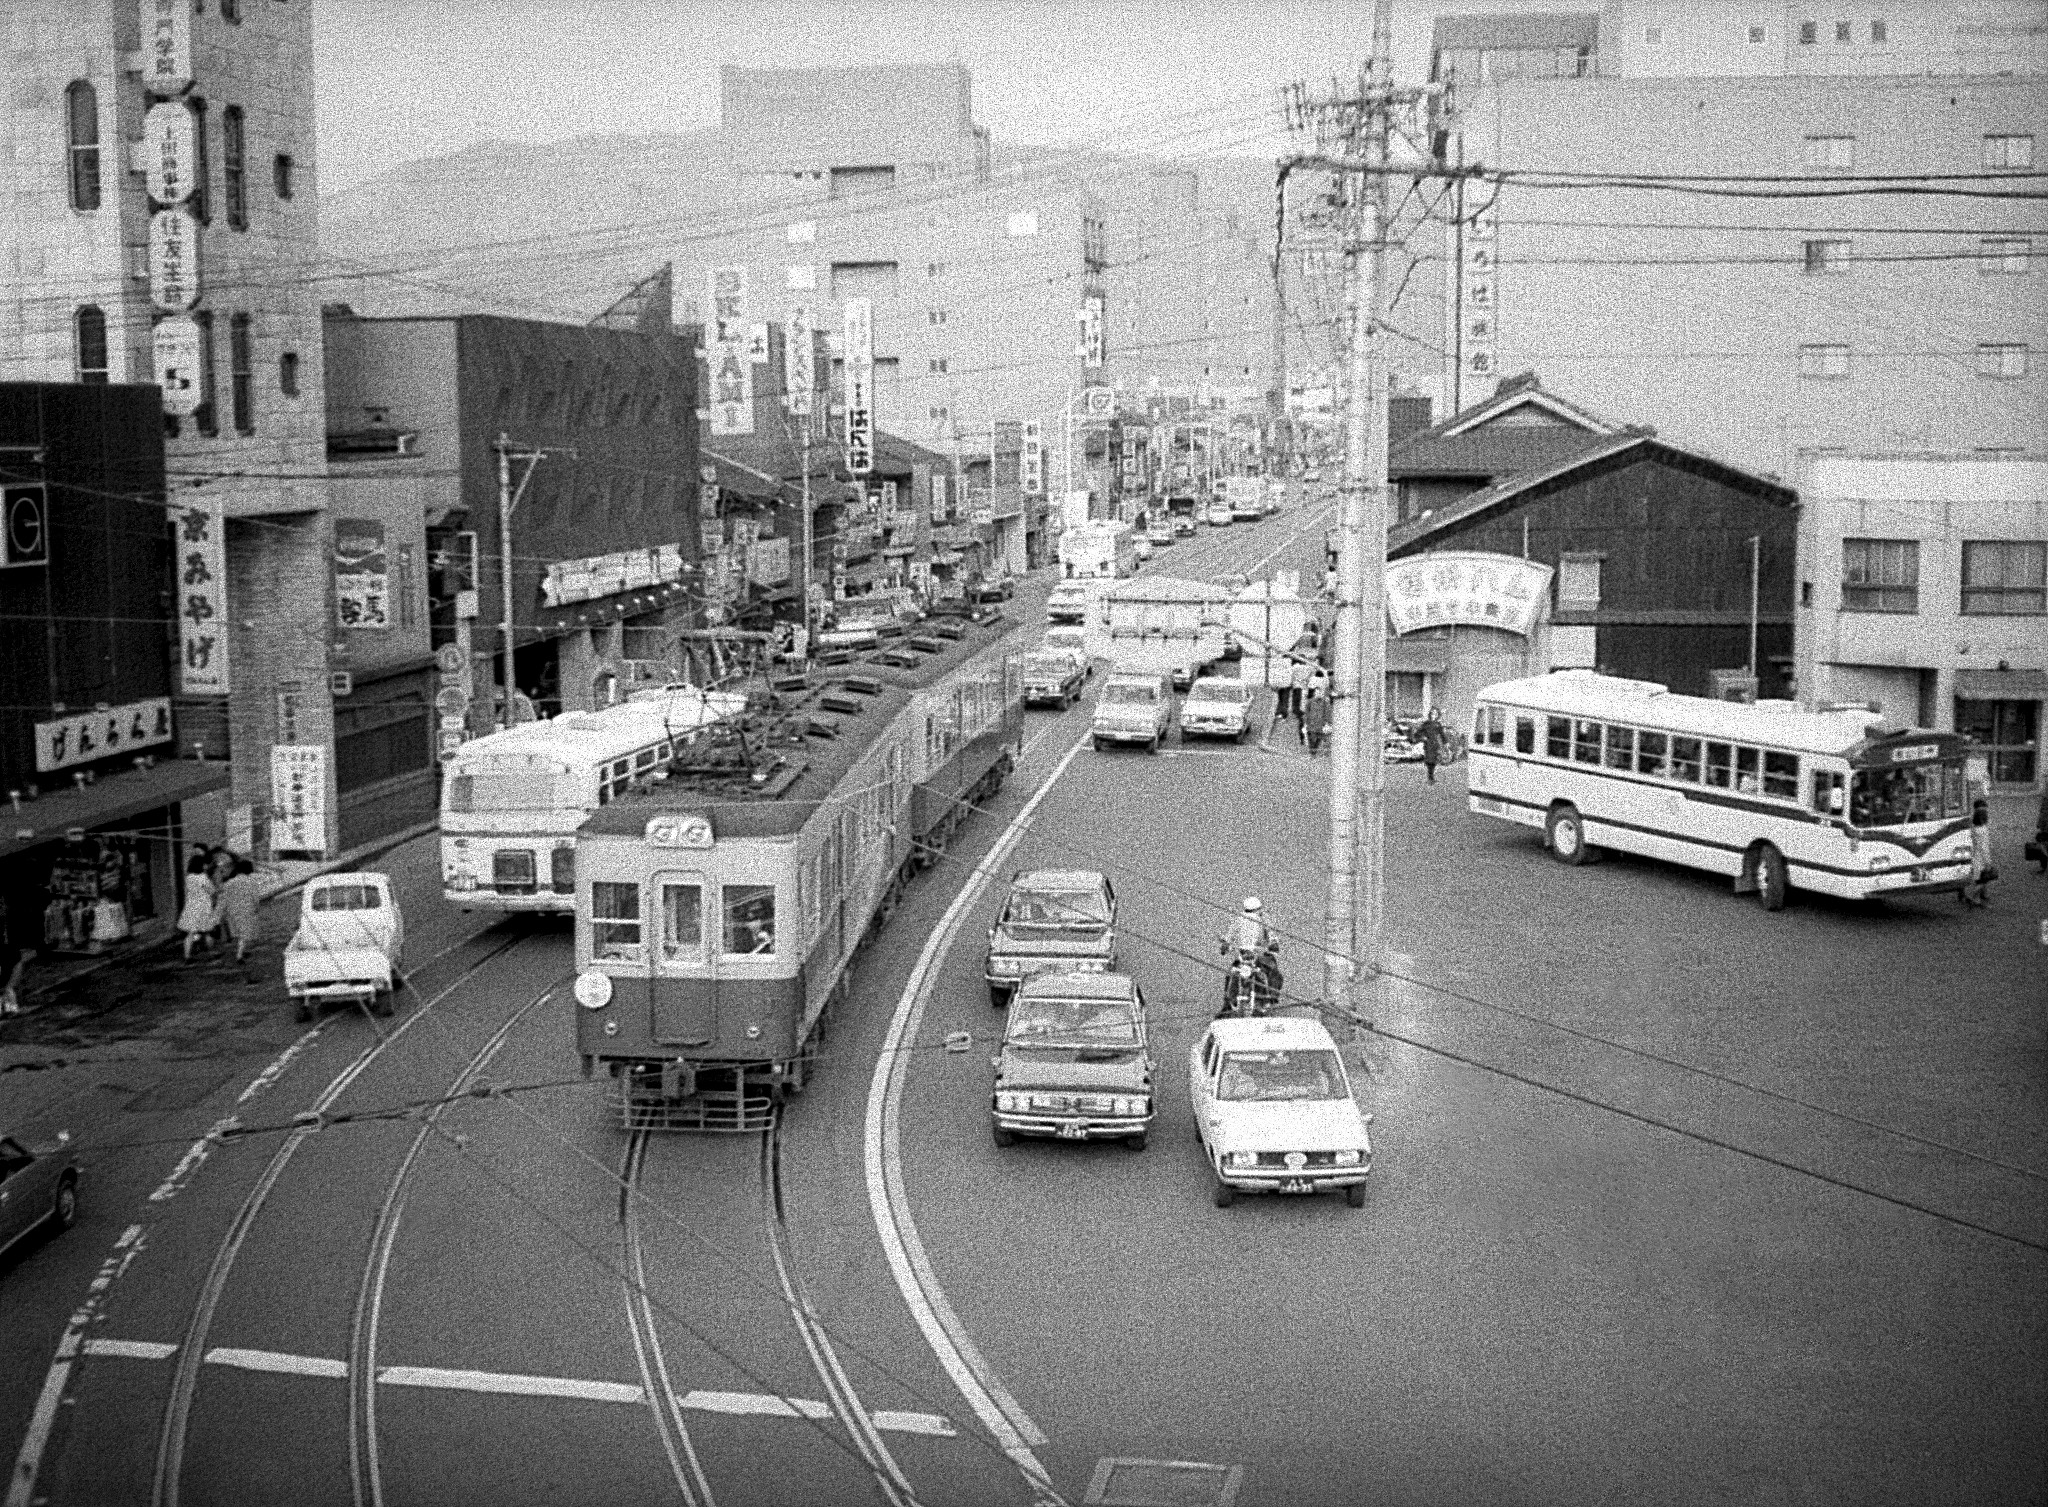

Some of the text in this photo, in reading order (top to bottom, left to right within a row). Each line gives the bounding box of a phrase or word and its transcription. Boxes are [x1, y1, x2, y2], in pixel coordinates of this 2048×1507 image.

[161, 215, 184, 304] 住友生命
[180, 508, 215, 669] 京みやげ
